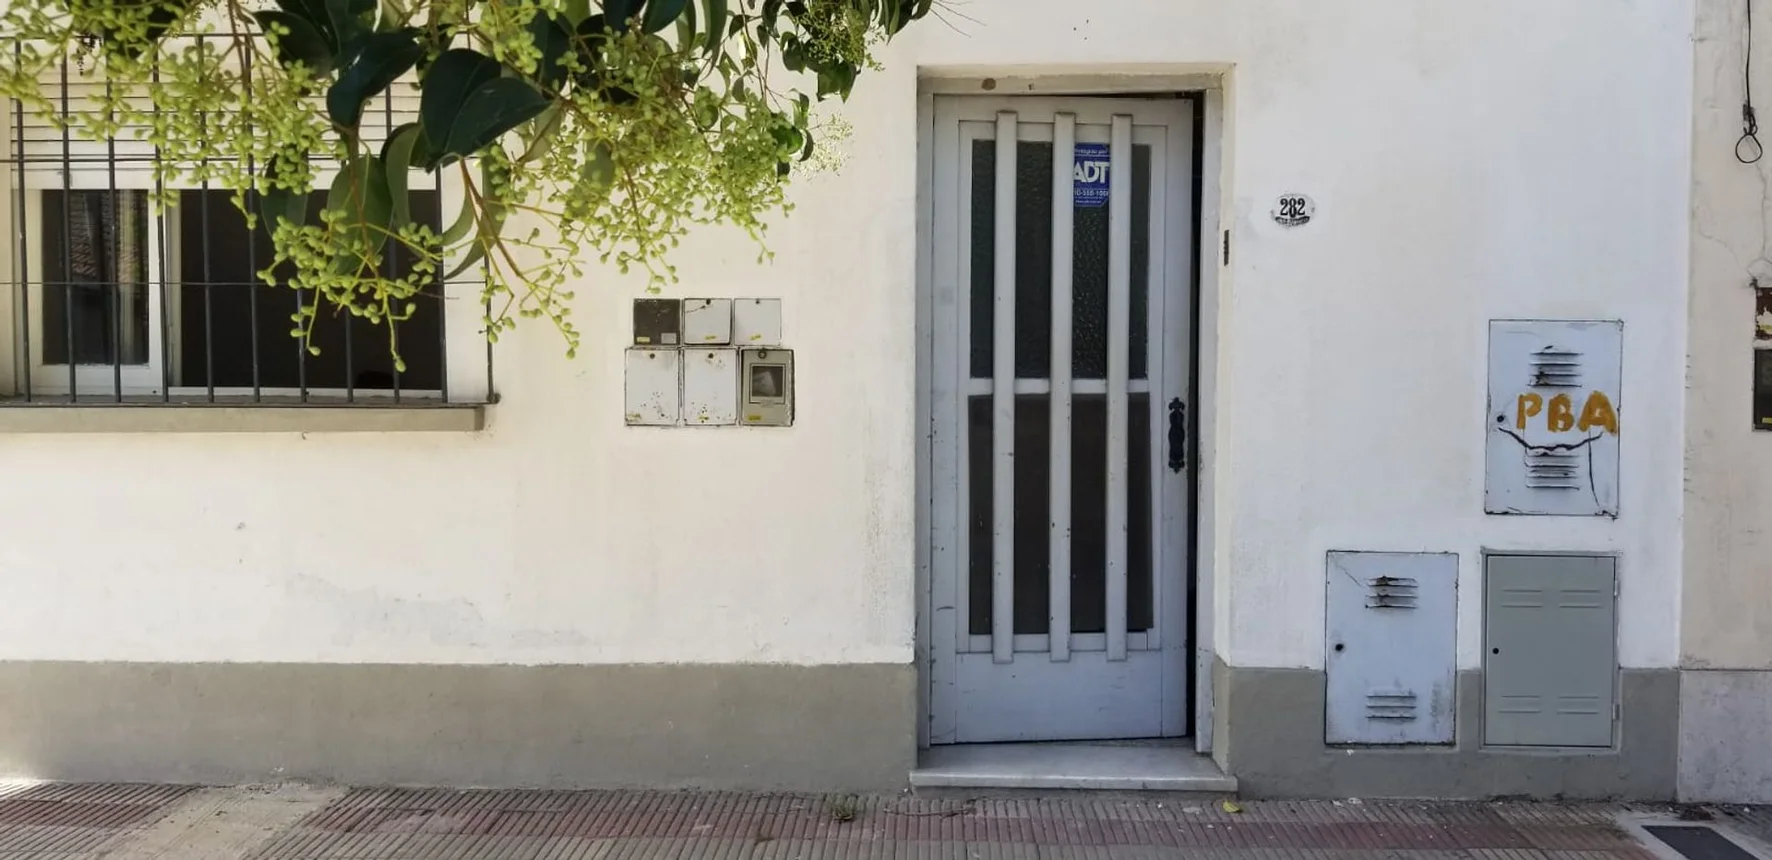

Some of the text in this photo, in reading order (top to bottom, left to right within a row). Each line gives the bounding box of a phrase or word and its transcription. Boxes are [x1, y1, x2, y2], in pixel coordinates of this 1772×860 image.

[1073, 161, 1110, 183] ADT
[1279, 197, 1306, 218] 282
[1516, 390, 1618, 437] PBA
